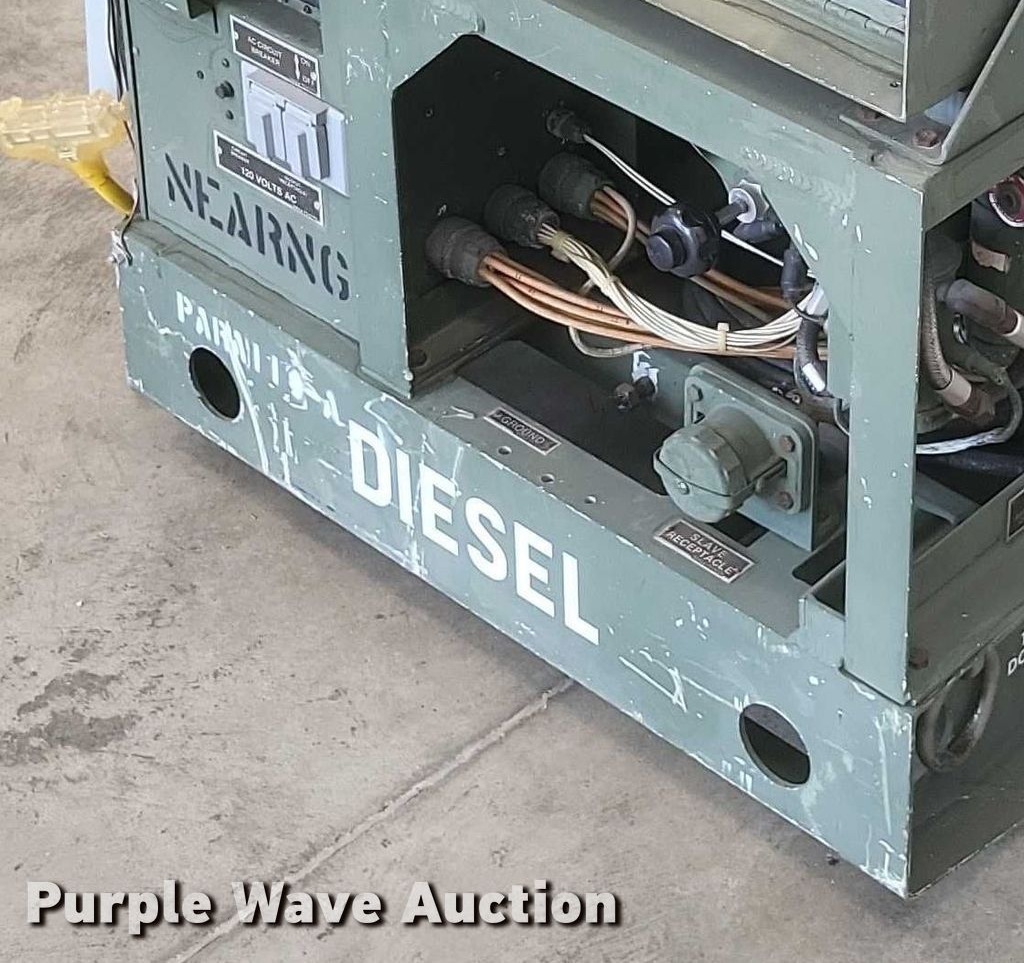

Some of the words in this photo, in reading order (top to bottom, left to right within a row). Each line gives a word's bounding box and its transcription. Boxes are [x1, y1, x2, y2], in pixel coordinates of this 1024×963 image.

[250, 46, 281, 67] BREAKER
[240, 166, 255, 181] 120
[255, 173, 284, 198] VOLTS
[284, 190, 298, 205] AC
[165, 152, 350, 301] NEARNG
[501, 414, 547, 446] GROUND
[346, 419, 600, 646] DIESEL
[690, 531, 728, 559] SLAVE
[666, 530, 740, 576] RECEPTACLE
